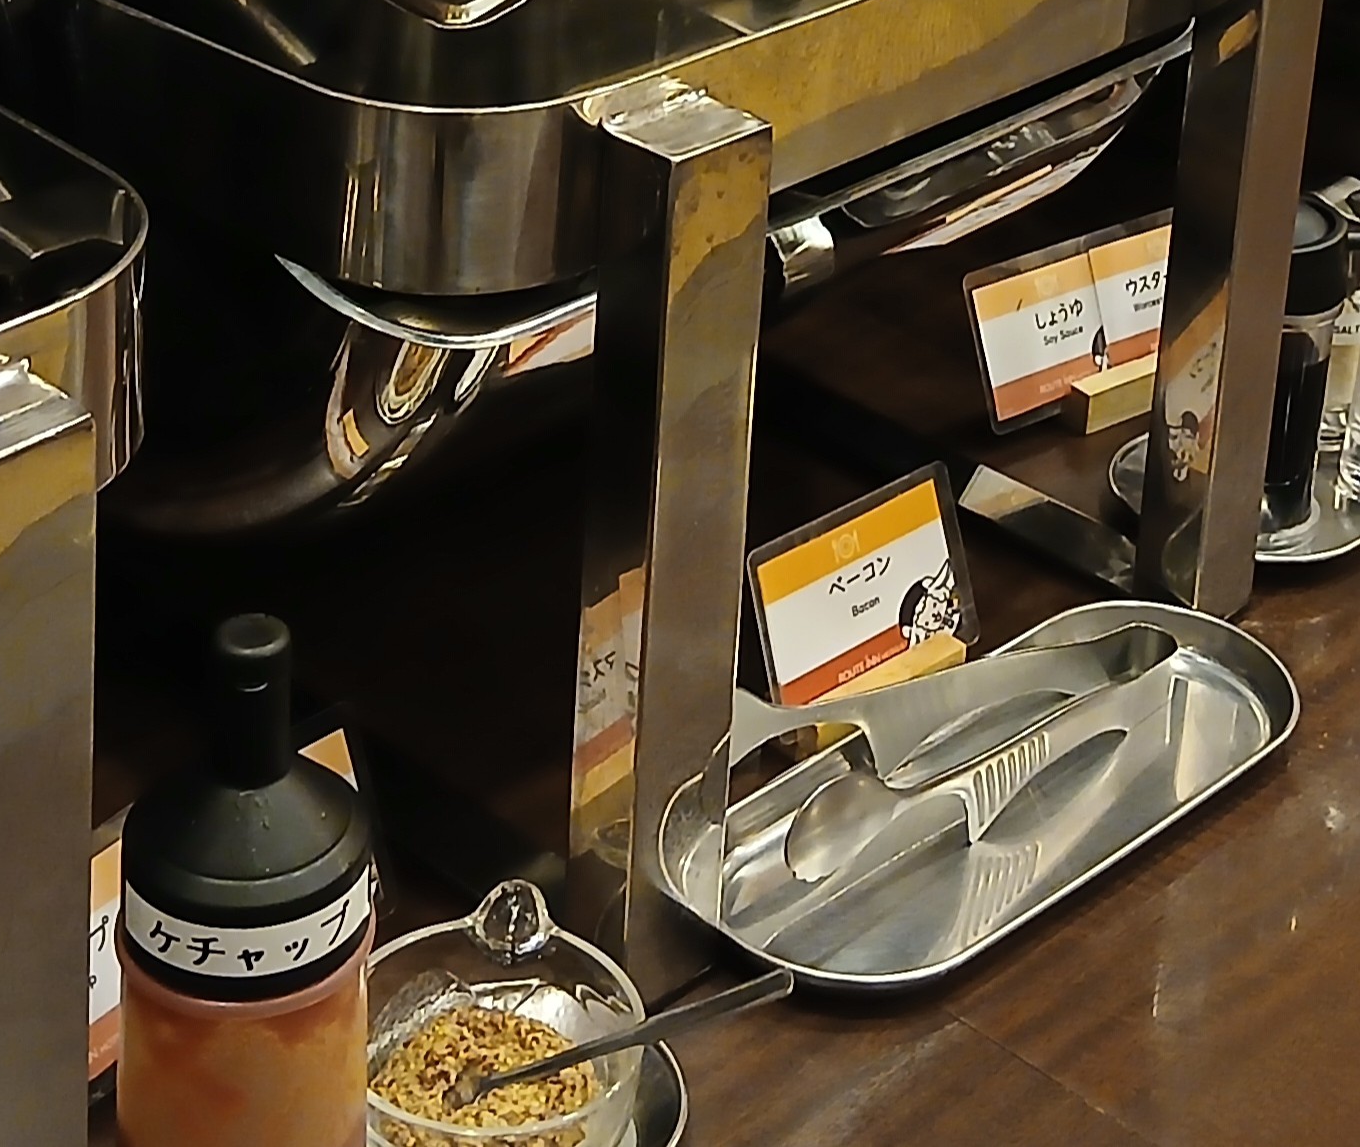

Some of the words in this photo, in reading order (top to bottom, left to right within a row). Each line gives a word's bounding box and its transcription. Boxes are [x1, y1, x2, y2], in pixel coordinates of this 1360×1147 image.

[1125, 270, 1167, 297] ウスタ
[1035, 298, 1083, 330] しょうゆ
[828, 556, 891, 595] ベーコン
[851, 596, 880, 618] Bacon
[149, 898, 351, 972] ケチャップ
